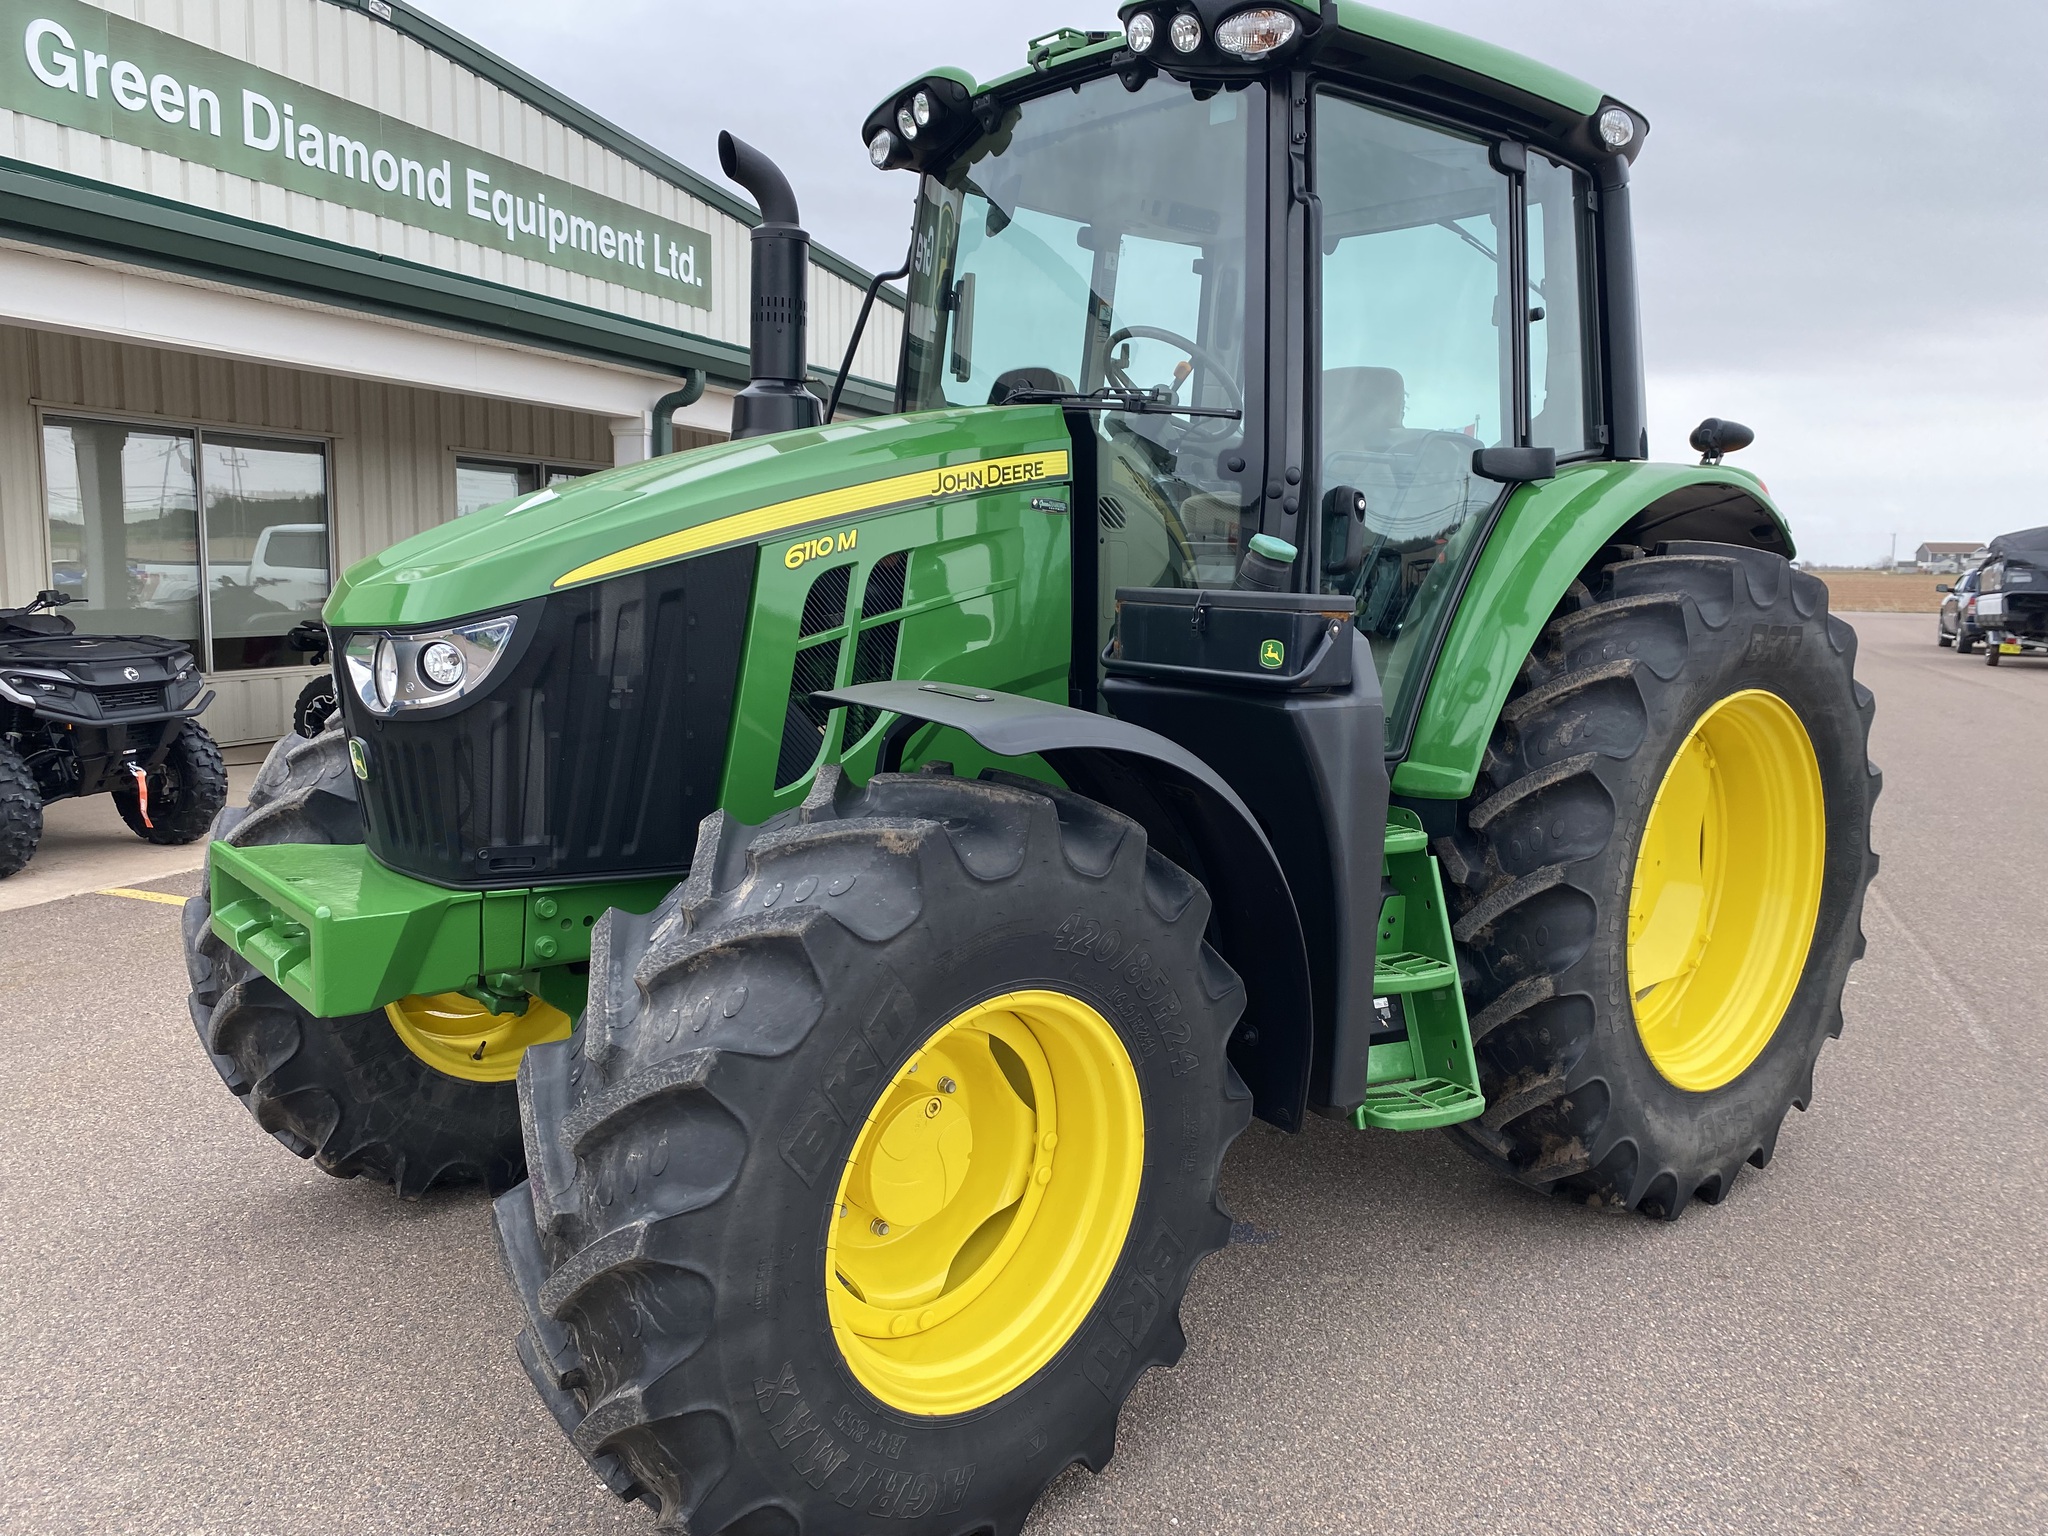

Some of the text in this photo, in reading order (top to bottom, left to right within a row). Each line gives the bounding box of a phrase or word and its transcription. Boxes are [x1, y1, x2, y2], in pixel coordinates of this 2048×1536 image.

[23, 18, 704, 287] Green Diamond Equipment Ltd.
[783, 528, 858, 570] 6110 M
[931, 460, 1045, 496] JOHN DEERE
[782, 970, 915, 1184] BKT
[1053, 912, 1201, 1079] 420/85R24
[1088, 1222, 1186, 1396] BKT
[831, 1403, 908, 1460] RT 855
